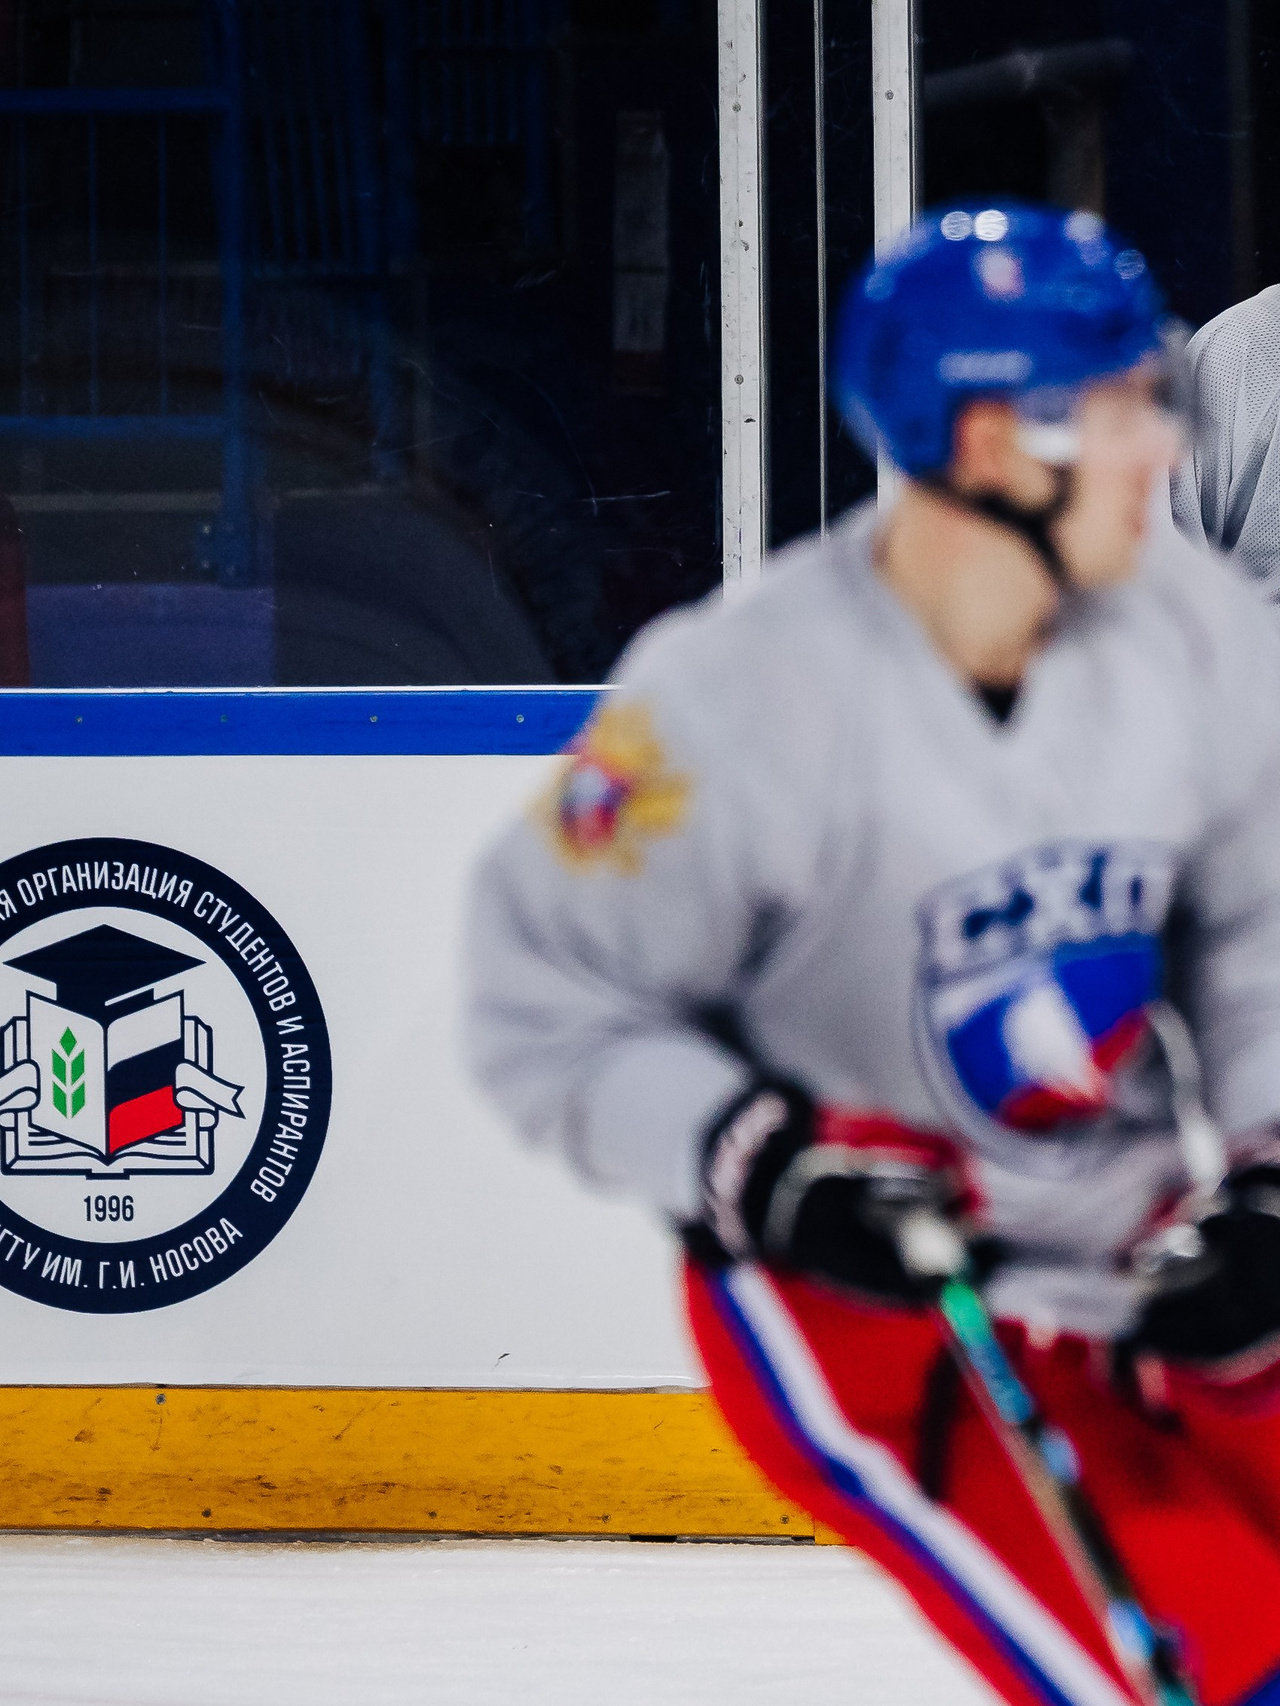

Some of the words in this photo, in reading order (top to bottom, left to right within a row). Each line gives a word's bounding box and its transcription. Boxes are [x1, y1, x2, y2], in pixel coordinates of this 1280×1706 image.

[16, 861, 194, 908] ОРГАНИЗАЦИЯ
[193, 891, 297, 1012] СТУДЕНТОВ
[275, 1015, 305, 1035] И
[250, 1043, 311, 1203] АСПИРАНТОВ
[83, 1195, 134, 1222] 1996
[0, 1224, 41, 1271] ГТУ
[41, 1251, 88, 1288] ИМ.
[149, 1218, 243, 1283] НОСОВА
